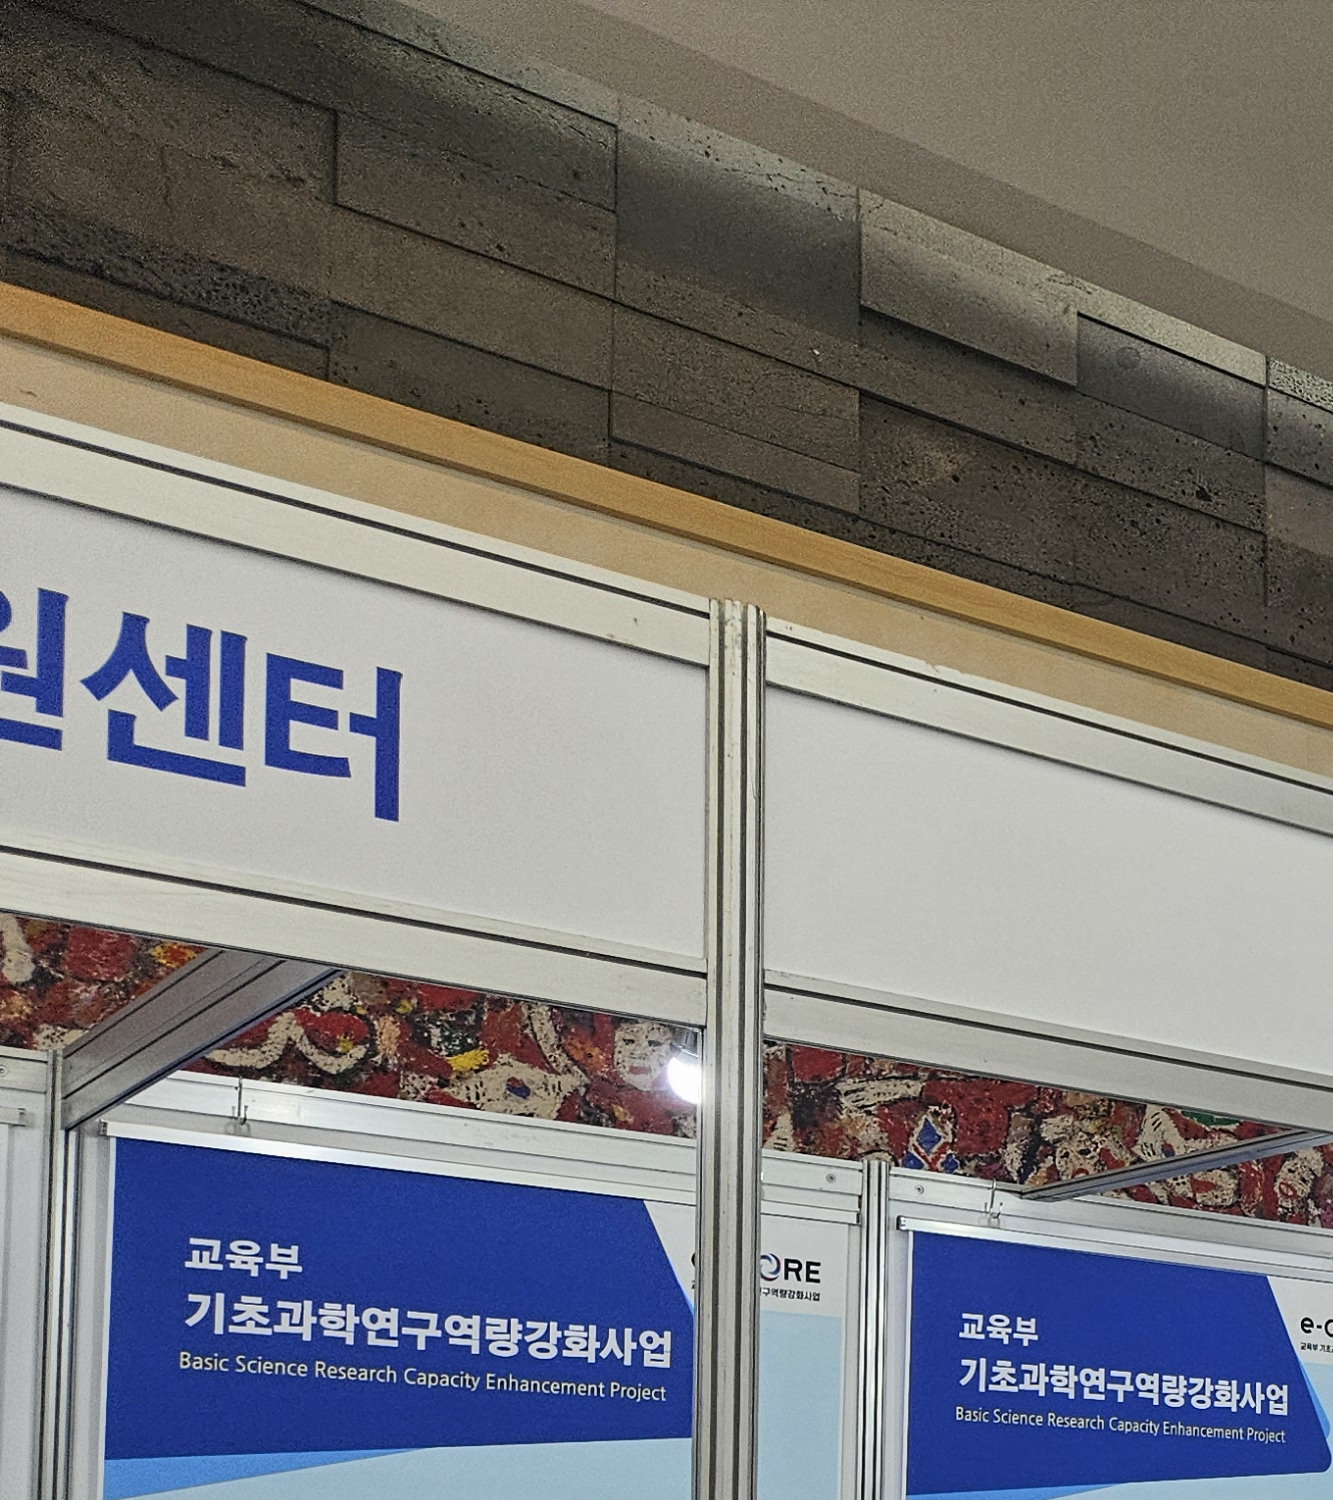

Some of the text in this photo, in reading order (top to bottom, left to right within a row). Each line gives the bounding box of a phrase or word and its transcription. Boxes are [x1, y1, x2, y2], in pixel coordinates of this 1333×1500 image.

[185, 1238, 302, 1279] 교육부
[185, 1293, 671, 1368] 기초과학연구역량강화사업
[959, 1313, 1038, 1346] 교육부
[180, 1352, 666, 1402] Basic Science Research Capacity Enhancement Project
[960, 1358, 1287, 1415] 기초과학연구역량강화사업
